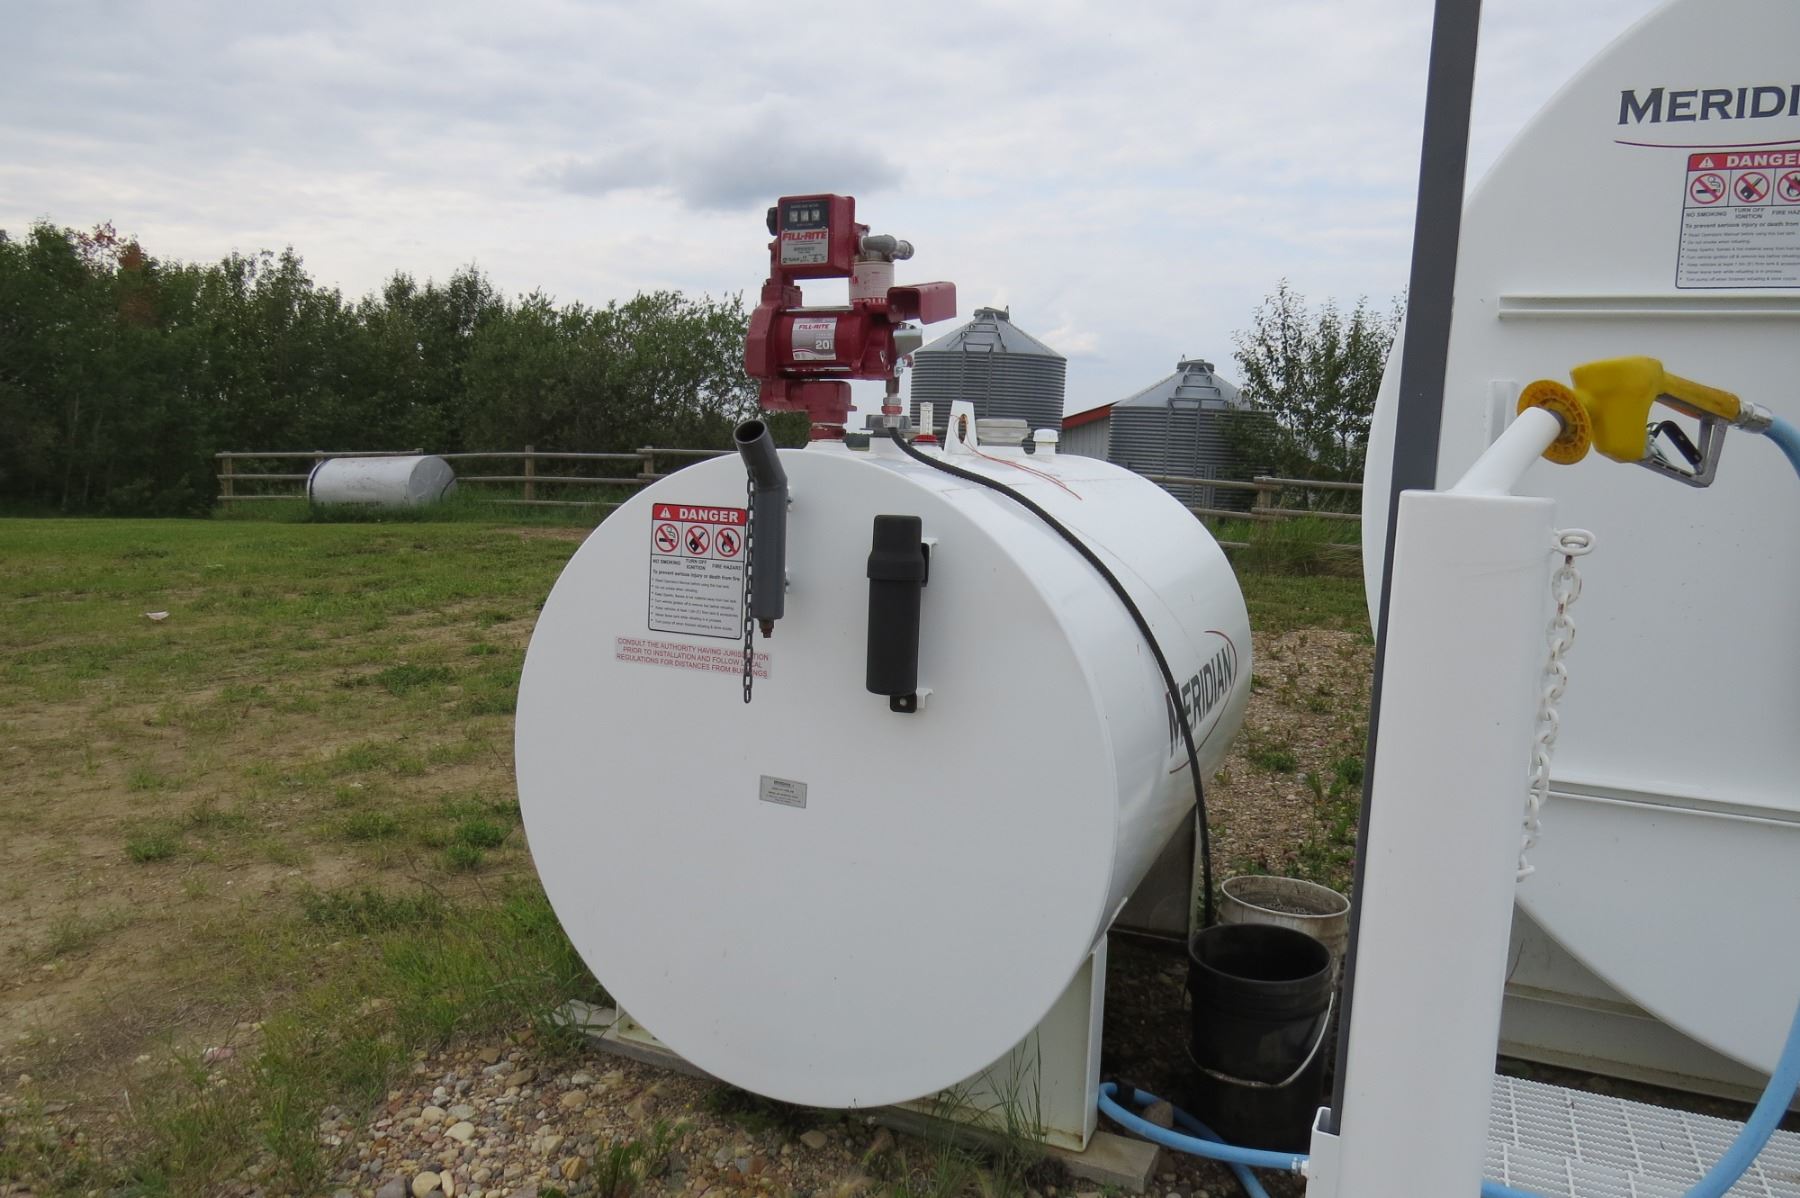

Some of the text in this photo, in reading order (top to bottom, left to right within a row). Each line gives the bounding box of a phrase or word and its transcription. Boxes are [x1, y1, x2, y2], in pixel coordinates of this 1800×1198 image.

[1726, 153, 1800, 168] DANGE
[782, 230, 827, 240] FILL-RITE
[679, 508, 738, 523] DANGER
[617, 637, 646, 646] CONSULT
[660, 642, 696, 652] AUTHORITY
[697, 647, 721, 655] HAVING
[616, 653, 659, 664] REGULATIONS
[674, 660, 710, 671] DISTANCES
[711, 664, 731, 673] FROM
[653, 649, 697, 660] INSTALLATION
[712, 656, 739, 665] FOLLOW
[1165, 643, 1233, 759] MERIDIAN
